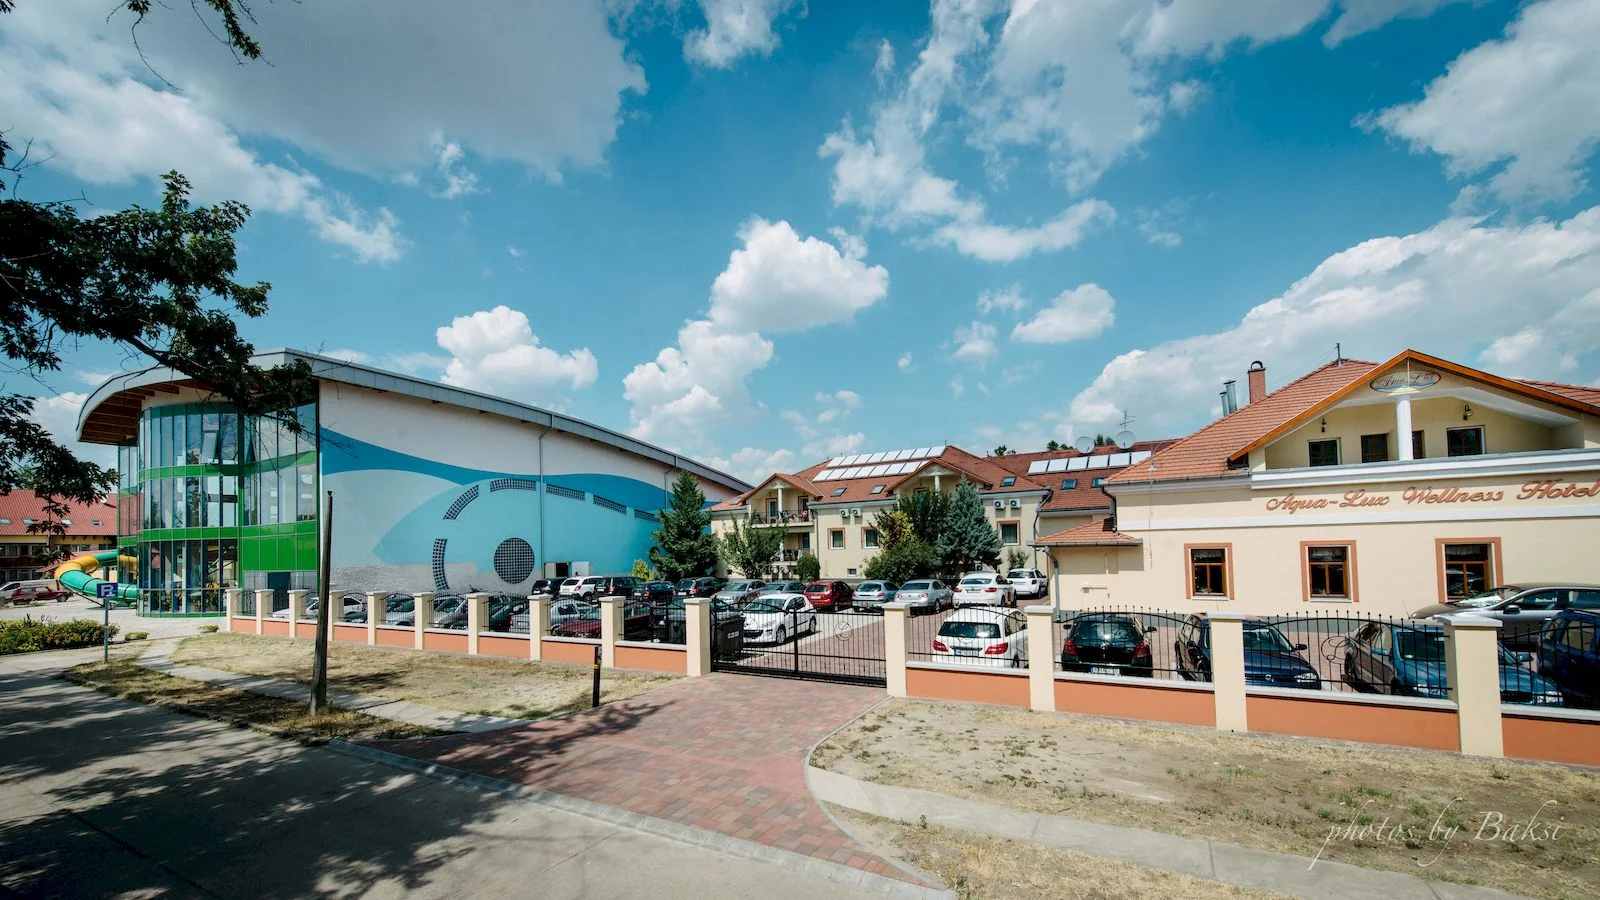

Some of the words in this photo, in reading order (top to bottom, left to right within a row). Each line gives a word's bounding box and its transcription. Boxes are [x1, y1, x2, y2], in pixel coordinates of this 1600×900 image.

[1266, 489, 1390, 514] Aqua-Lux
[1402, 486, 1504, 505] Wellness
[1516, 479, 1600, 500] Hotel
